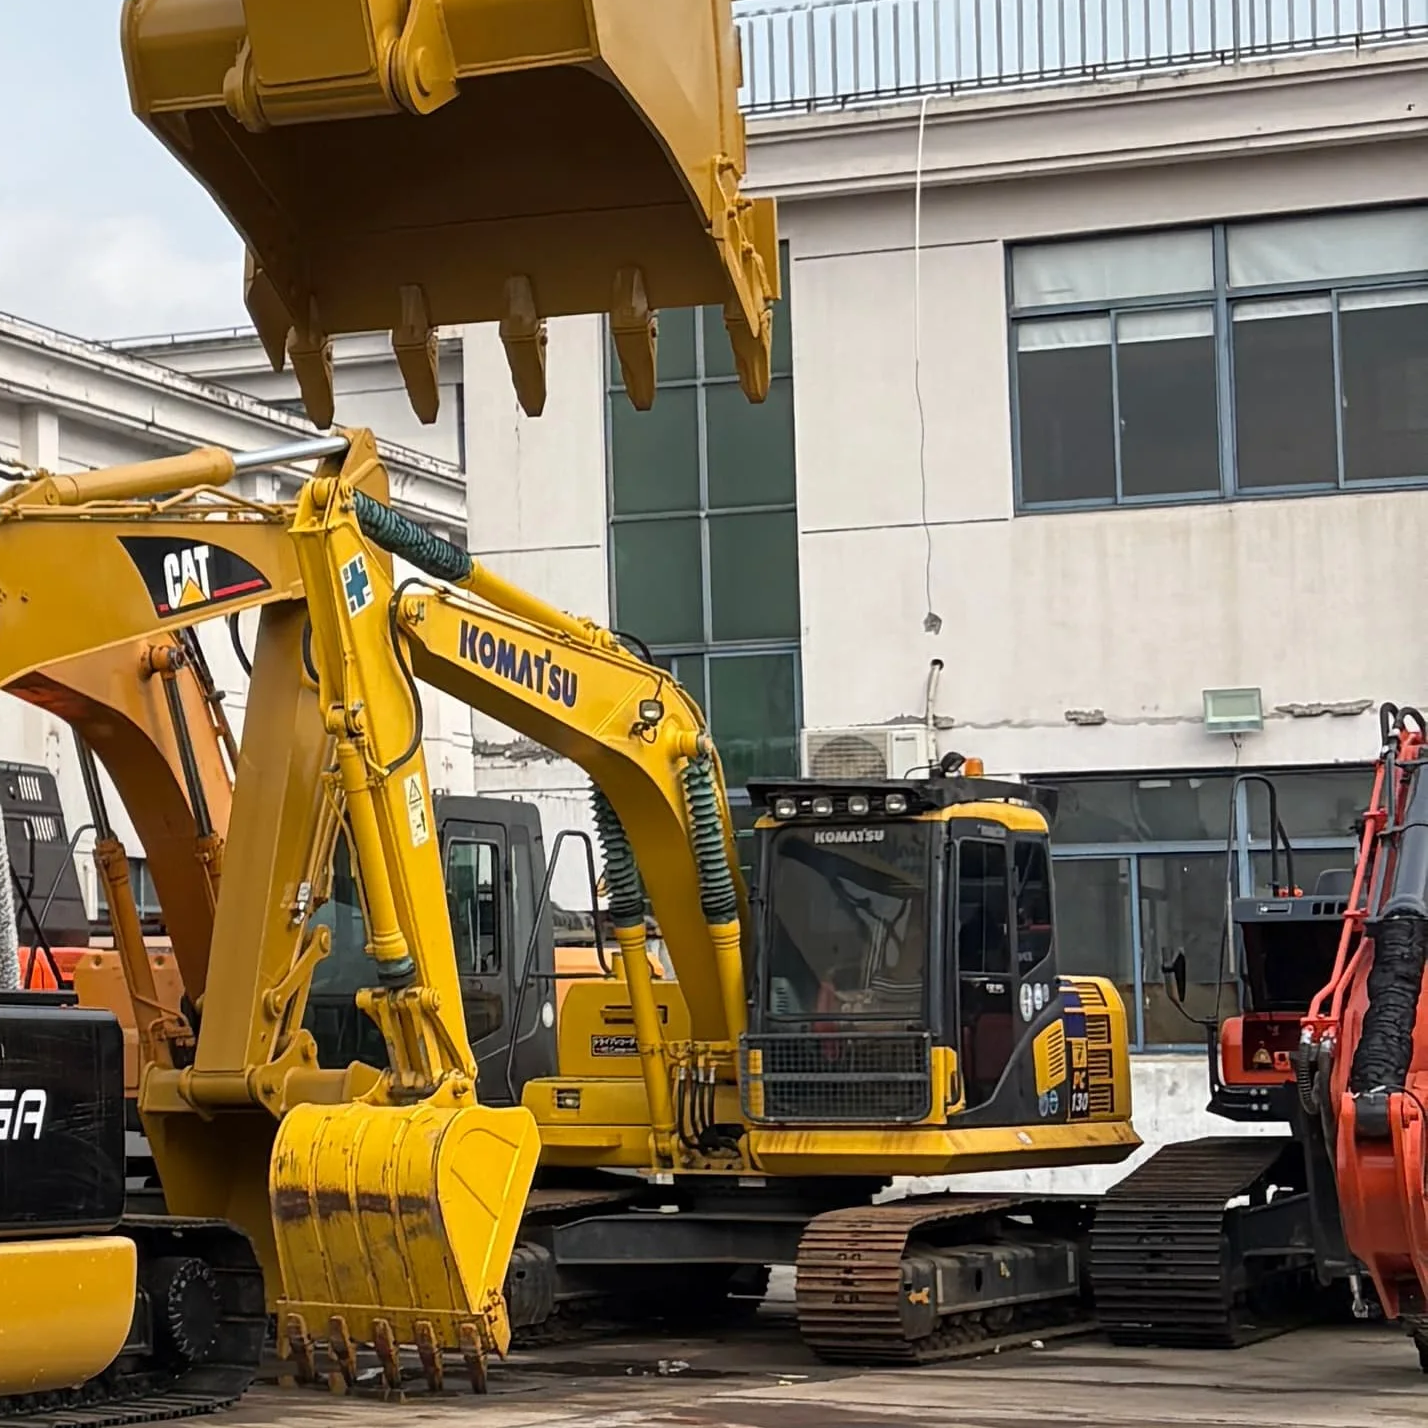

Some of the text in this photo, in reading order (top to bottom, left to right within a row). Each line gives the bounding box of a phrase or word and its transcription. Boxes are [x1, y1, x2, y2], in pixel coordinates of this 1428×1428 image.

[163, 545, 211, 609] CAT
[459, 619, 578, 707] KOMATSU
[815, 828, 884, 844] KOMATSU
[1072, 1092, 1088, 1111] 130
